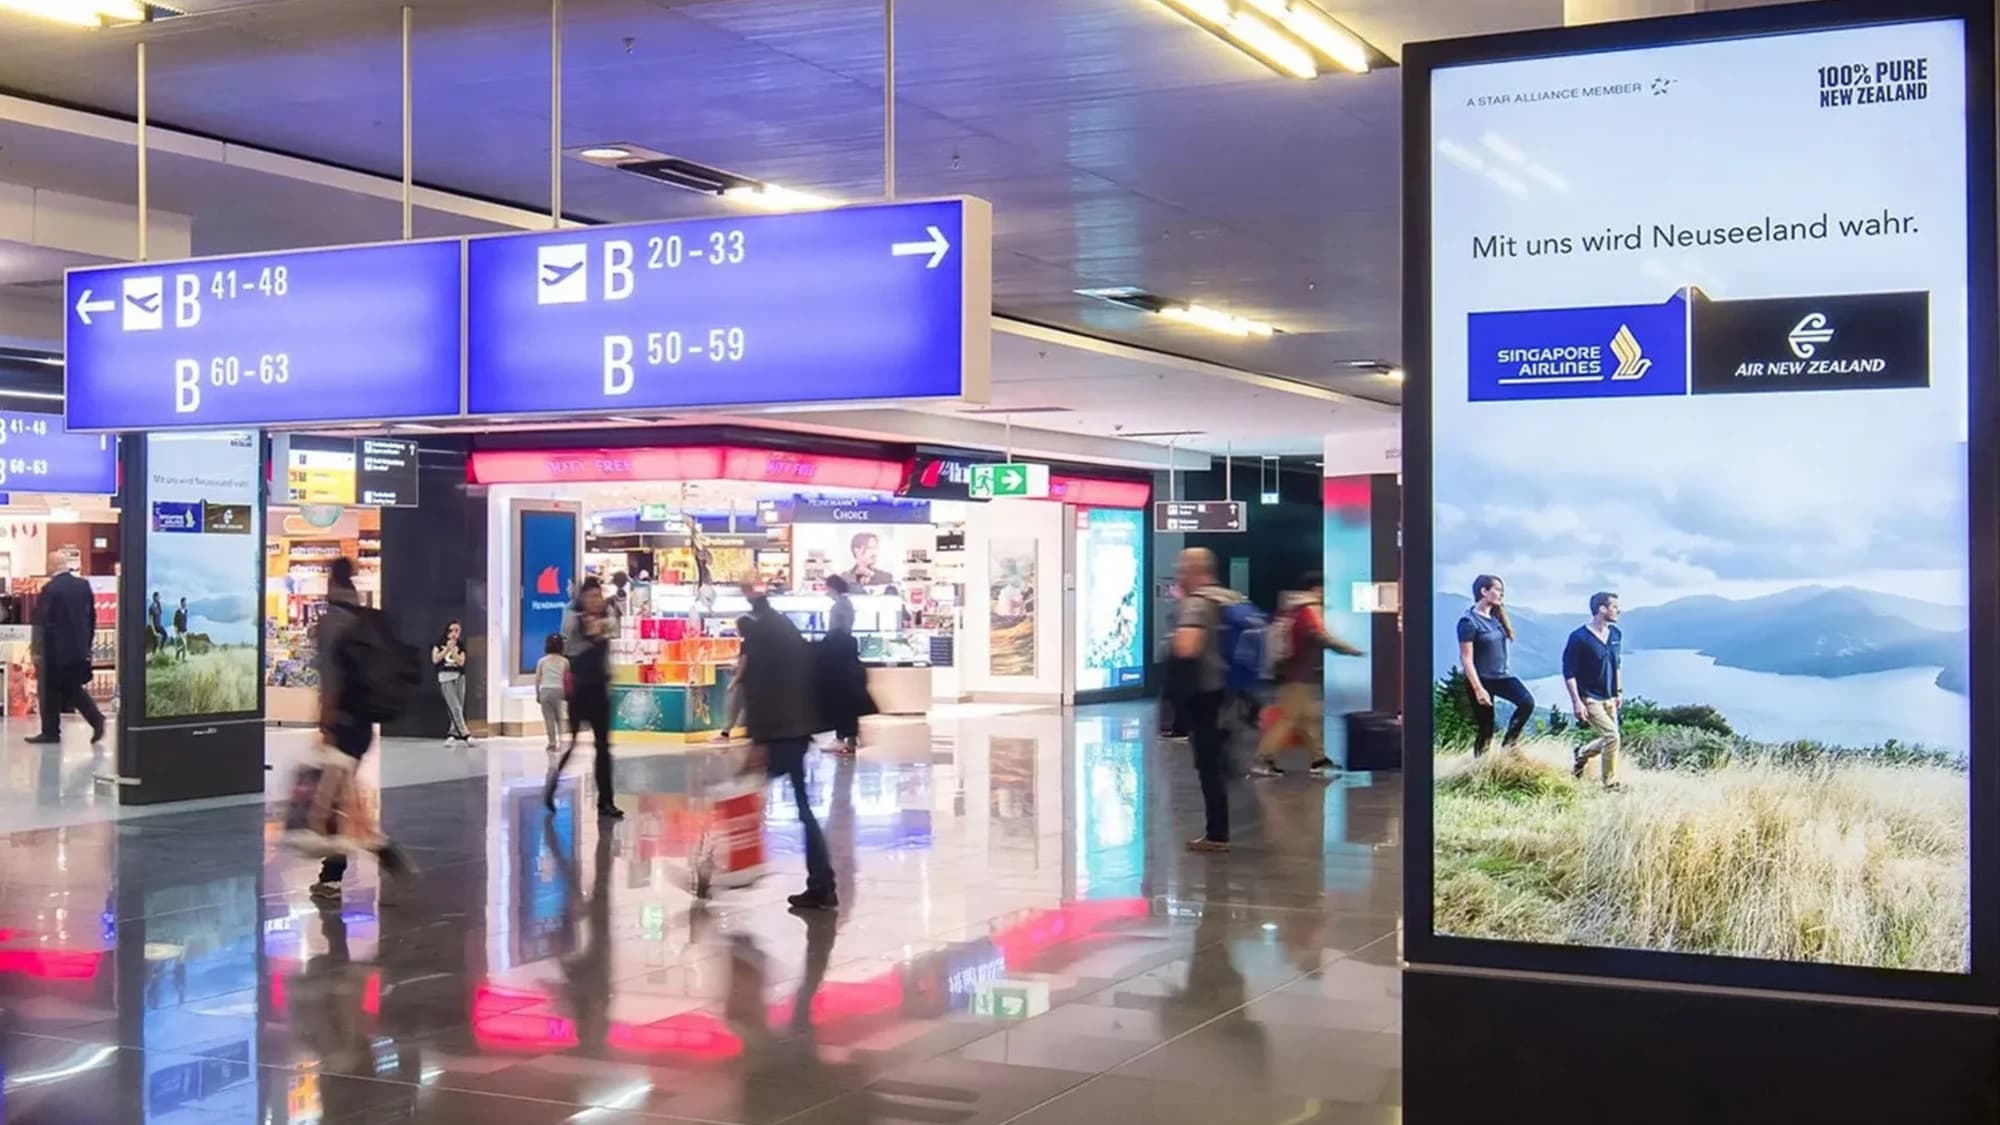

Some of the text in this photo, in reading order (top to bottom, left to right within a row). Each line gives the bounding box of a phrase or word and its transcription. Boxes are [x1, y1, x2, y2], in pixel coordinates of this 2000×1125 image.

[1818, 57, 1927, 88] 100% PURE
[1466, 82, 1642, 108] A STAR ALLIANCE MEMBER
[1820, 82, 1928, 108] NEW ZEALAND
[1473, 208, 1919, 258] Mit uns wird Neuseeland wahr.
[604, 239, 635, 300] B
[175, 273, 201, 329] B
[603, 334, 635, 396] B
[1497, 346, 1602, 363] SINGAPORE
[1518, 361, 1602, 377] AIRLINES
[1734, 357, 1886, 377] AIR NEW ZEALAND
[175, 358, 201, 413] B
